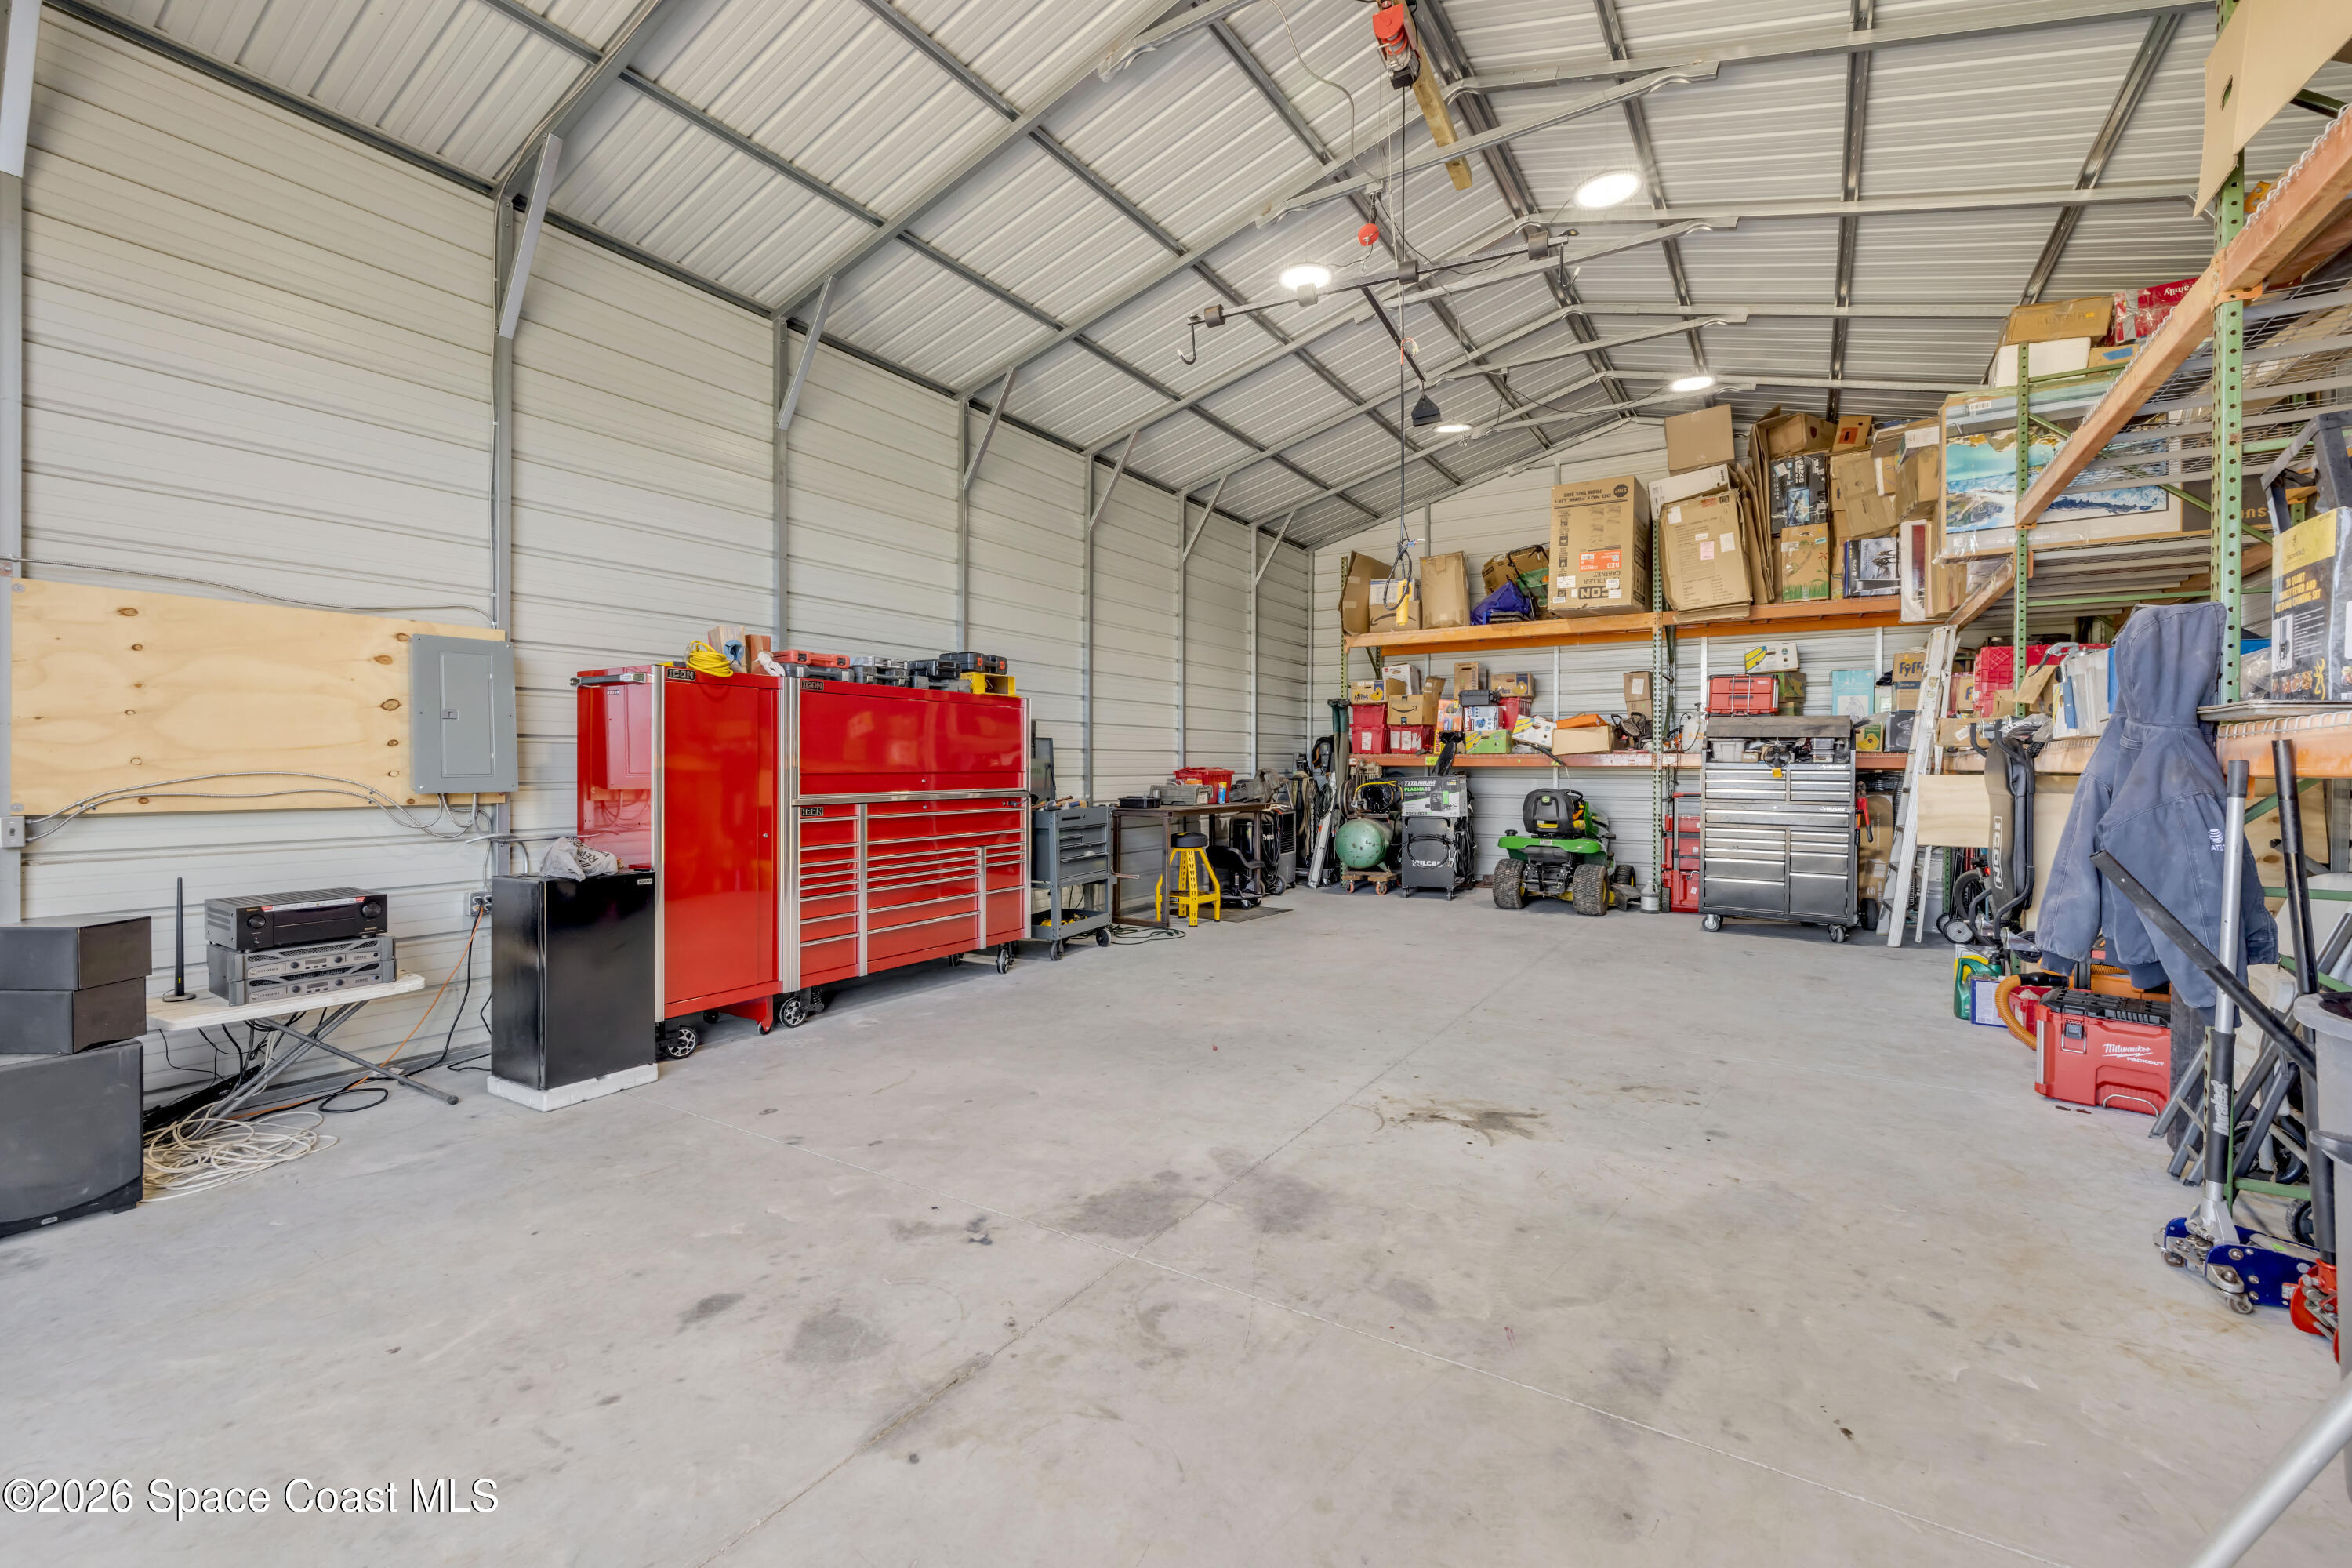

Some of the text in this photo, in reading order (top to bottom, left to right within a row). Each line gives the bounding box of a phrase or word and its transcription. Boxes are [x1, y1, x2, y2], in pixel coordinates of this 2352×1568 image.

[2164, 283, 2190, 296] amily
[2306, 579, 2317, 591] AND
[2312, 589, 2321, 600] SET
[668, 669, 695, 680] ICON
[1899, 661, 1924, 677] Fyff
[802, 681, 822, 690] ICON
[1993, 822, 2002, 884] ICON
[2102, 1043, 2151, 1053] Milwaukee
[2126, 1057, 2164, 1066] PACKOUT
